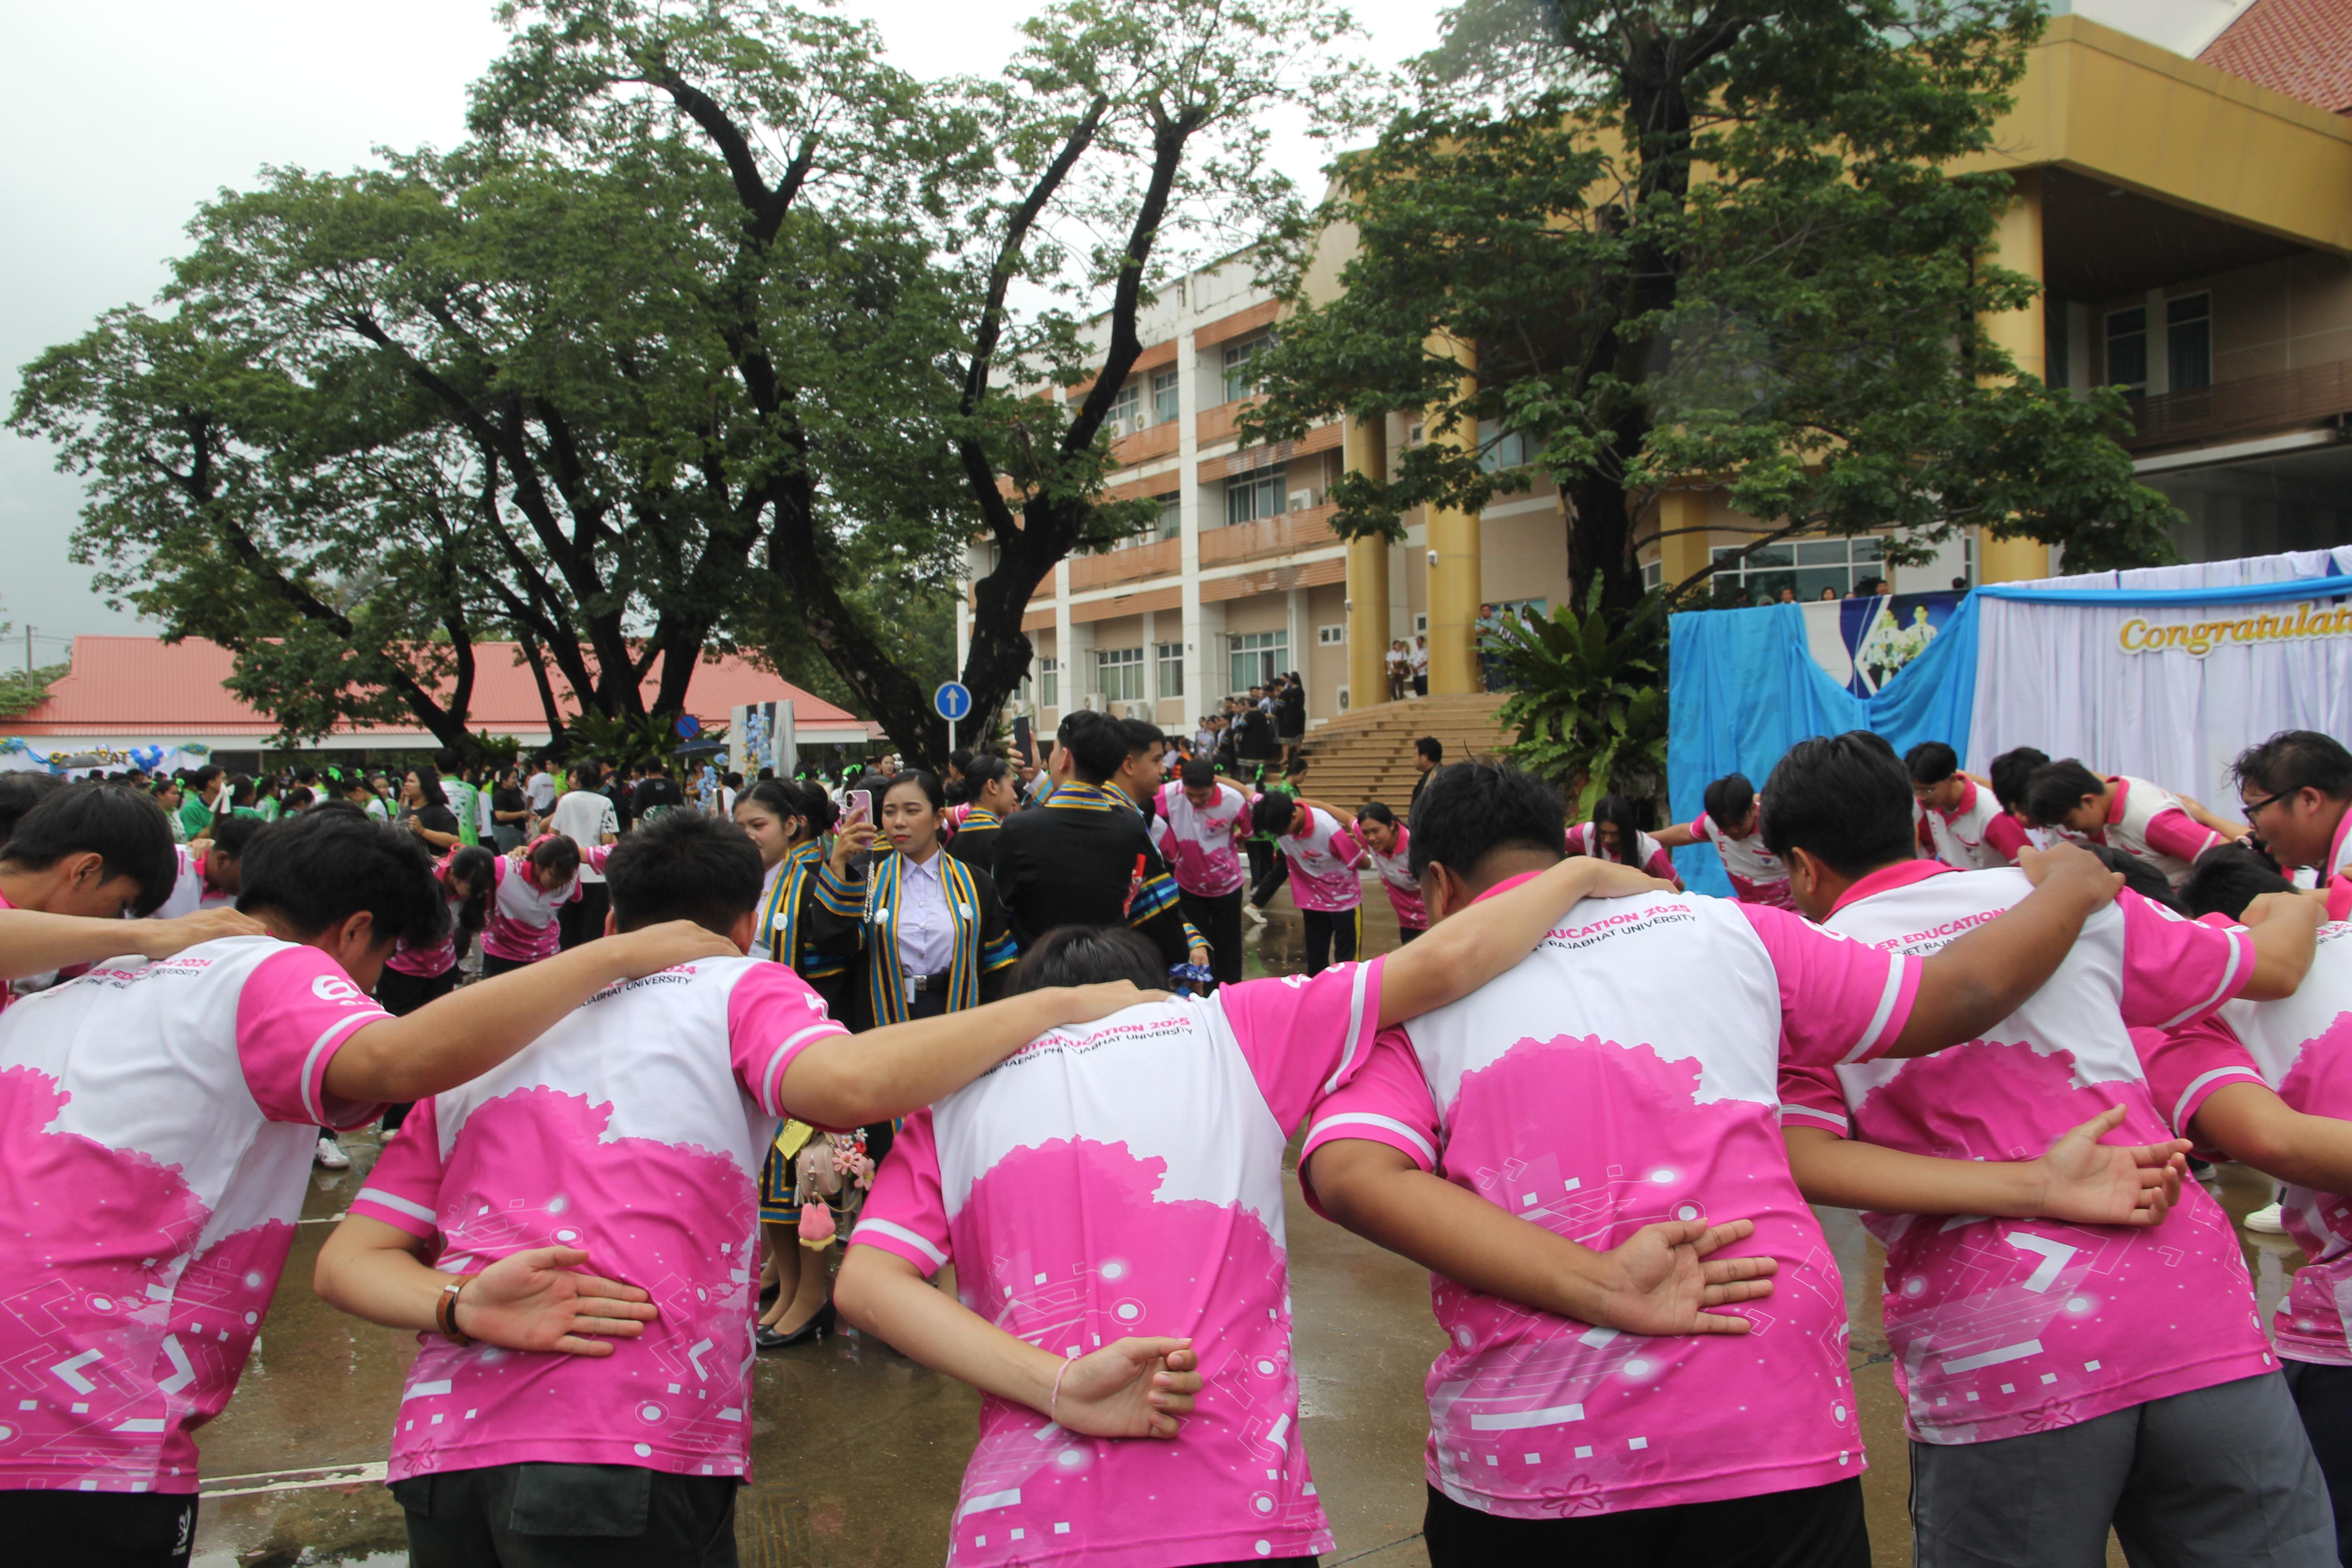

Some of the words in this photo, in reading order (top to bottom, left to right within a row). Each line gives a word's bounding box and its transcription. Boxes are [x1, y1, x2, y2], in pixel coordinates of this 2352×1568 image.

[1543, 912, 1640, 939] UCATION
[1644, 904, 1691, 917] 2025
[1548, 929, 1616, 950] RAJABHAT
[1621, 914, 1696, 935] UNIVERSITY
[580, 986, 621, 1006] JABHAT
[626, 975, 692, 991] UNIVERSITY
